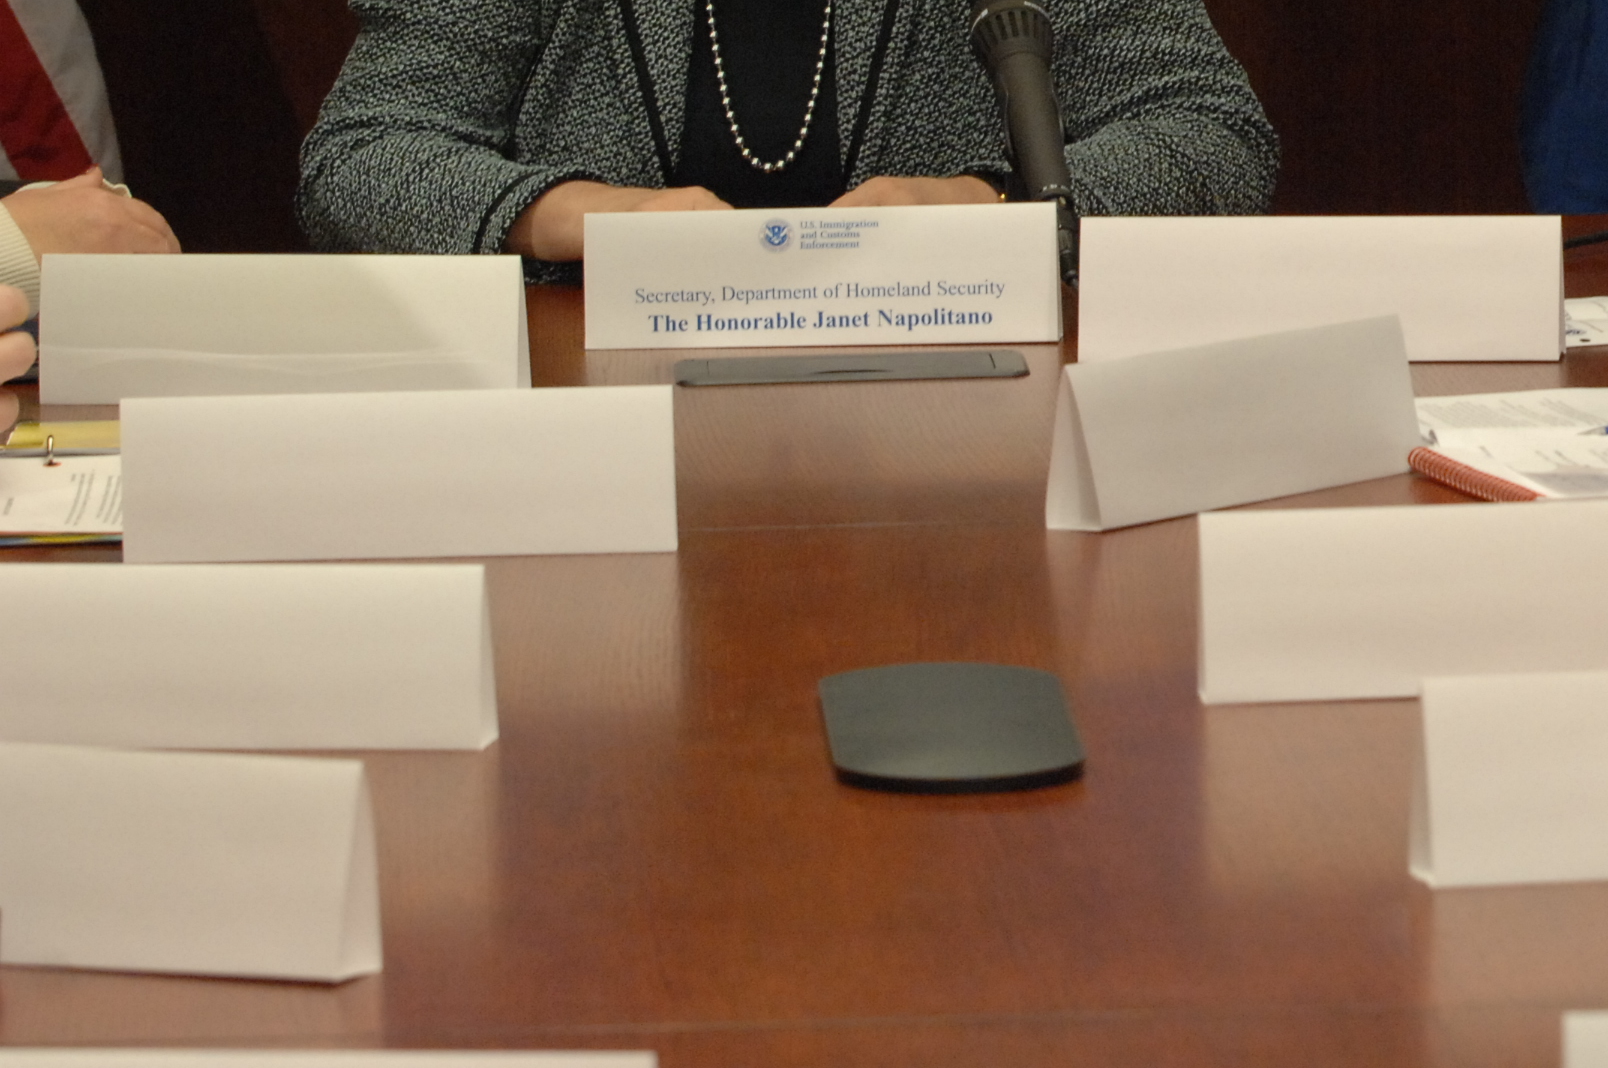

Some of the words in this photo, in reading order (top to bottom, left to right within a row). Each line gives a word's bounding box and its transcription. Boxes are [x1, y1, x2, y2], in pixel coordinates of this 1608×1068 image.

[800, 220, 817, 229] U.S.
[820, 219, 879, 231] Immigration
[800, 231, 817, 239] and
[820, 230, 860, 239] Customs
[800, 240, 859, 250] Enforcement
[635, 287, 715, 306] Secretary,
[722, 285, 817, 305] Department
[823, 283, 842, 298] of
[847, 281, 932, 298] Homeland
[937, 279, 1005, 299] Security
[648, 314, 688, 333] The
[696, 312, 807, 332] Honorable
[813, 310, 870, 329] Janet
[877, 308, 993, 331] Napolitano
